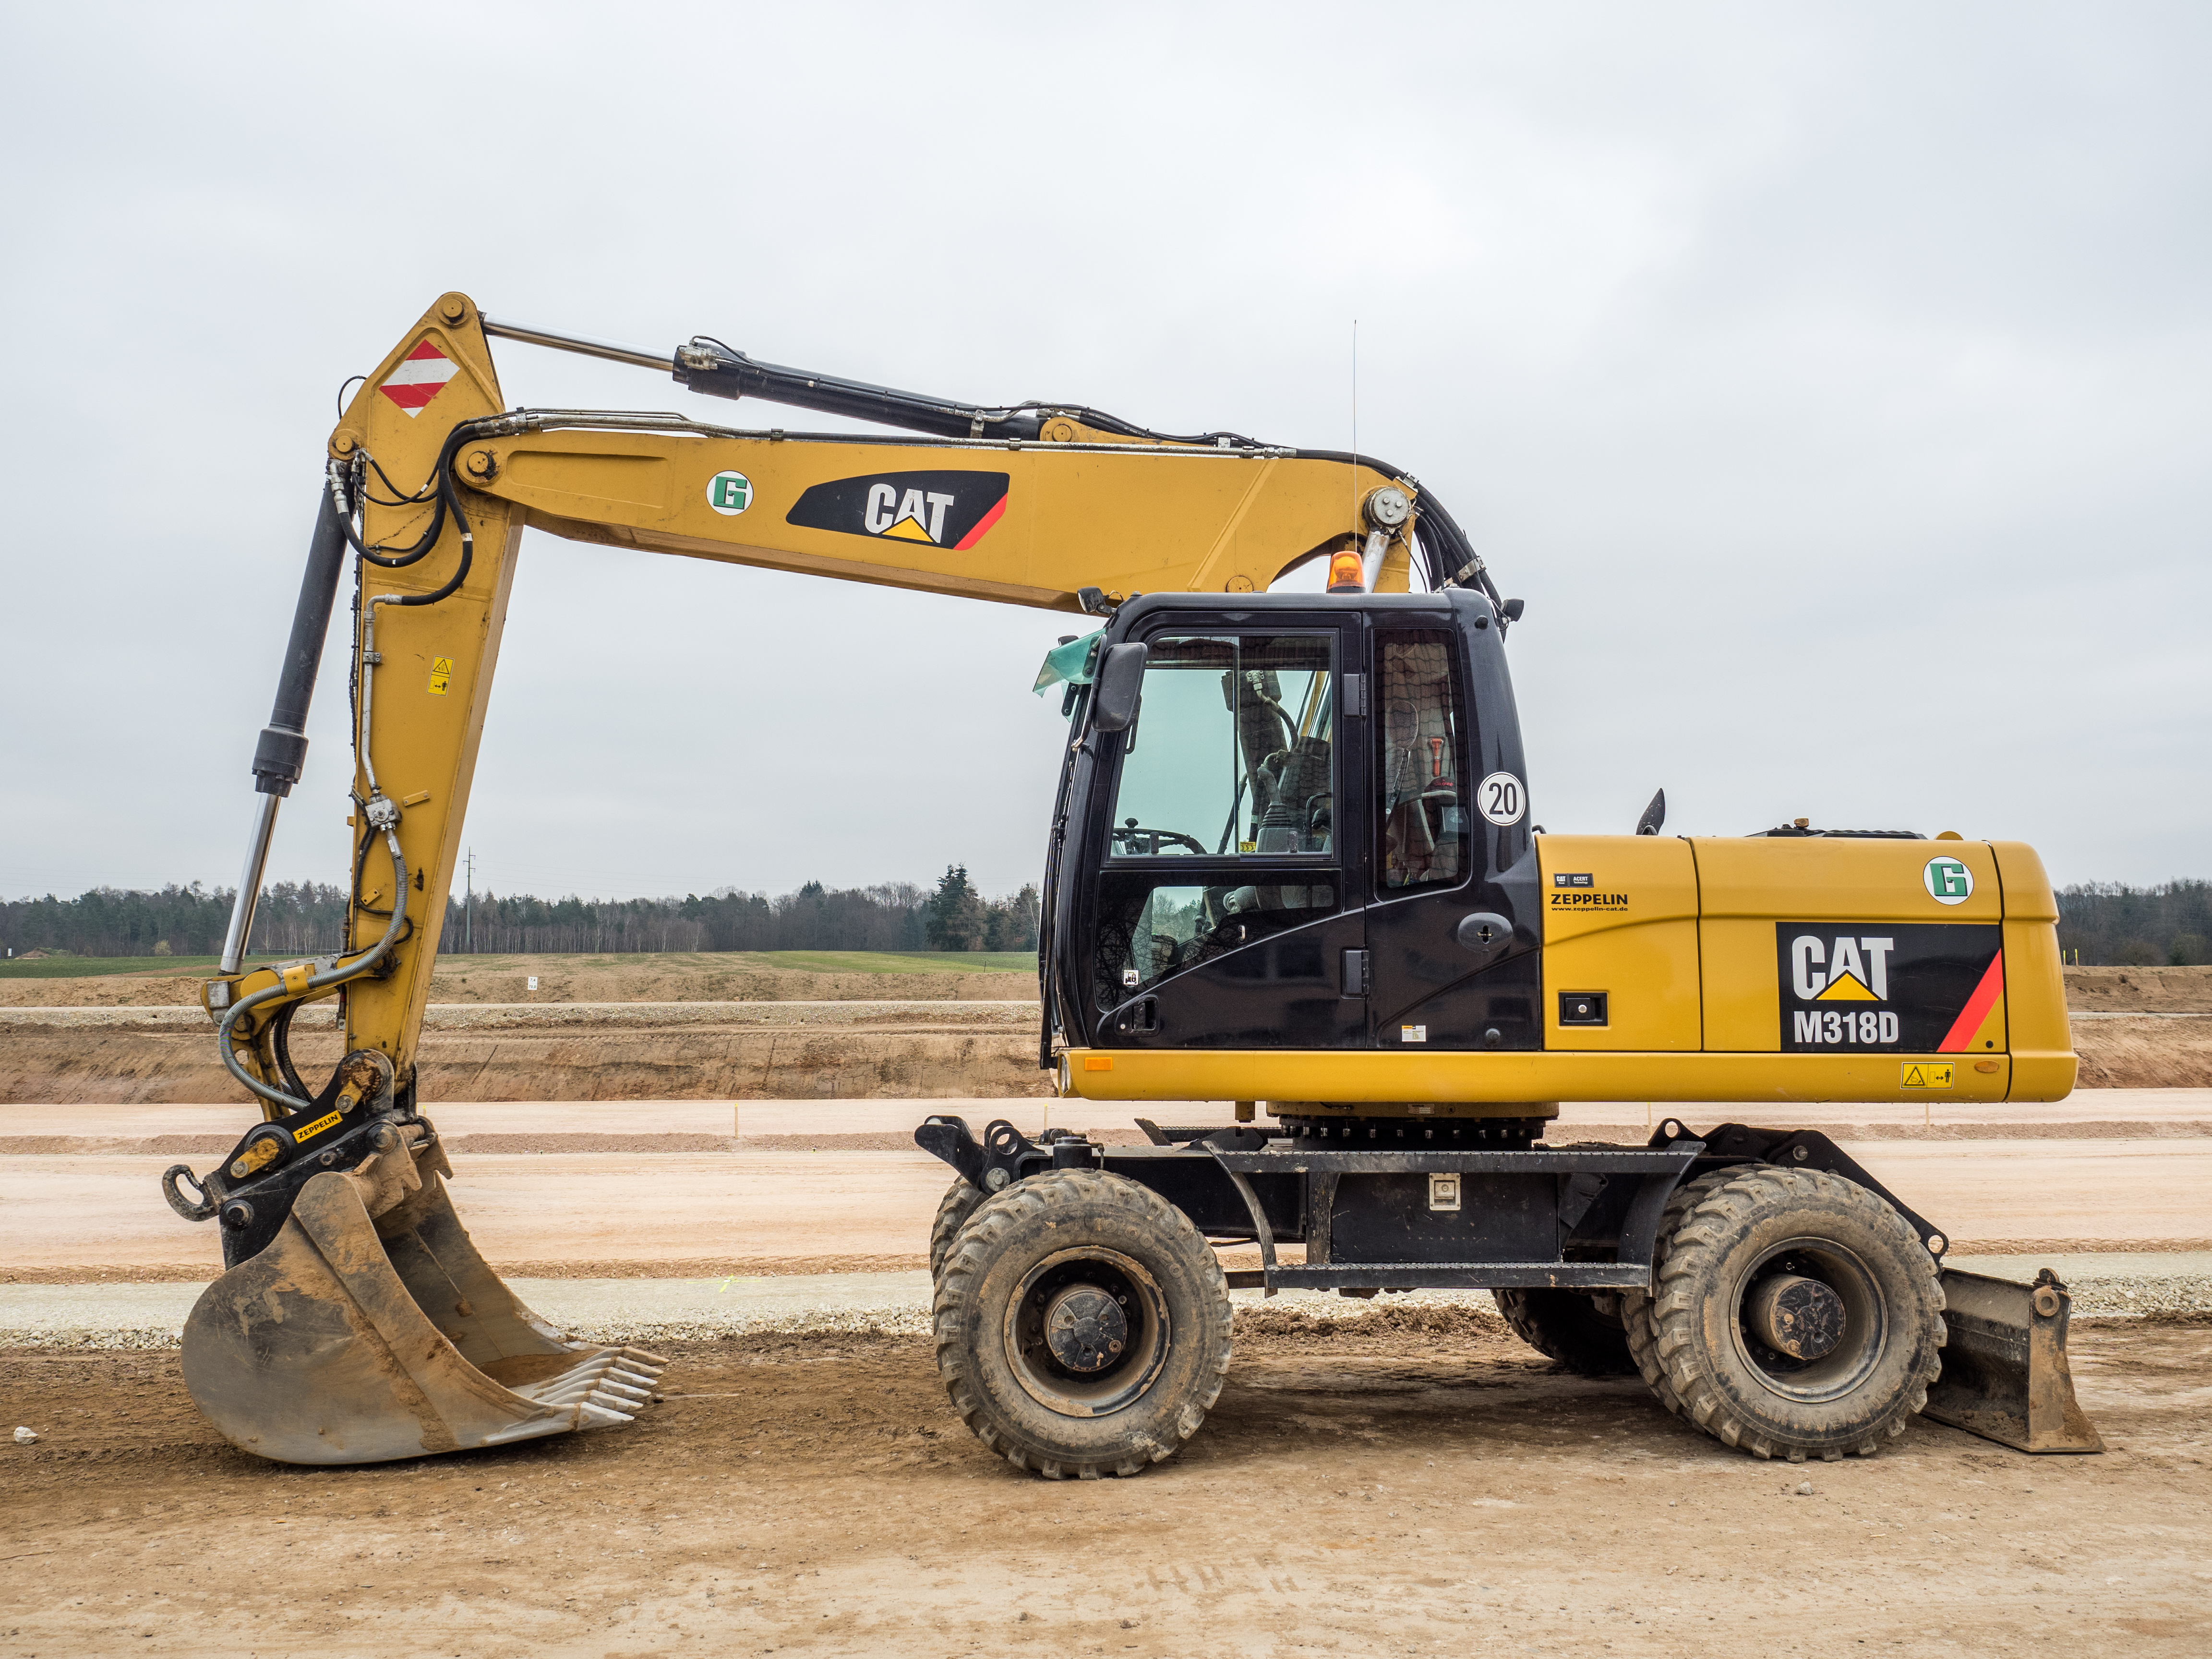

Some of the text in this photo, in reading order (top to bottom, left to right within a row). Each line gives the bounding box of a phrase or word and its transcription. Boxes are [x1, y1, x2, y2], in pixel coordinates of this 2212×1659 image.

[713, 476, 747, 510] G
[865, 483, 954, 543] CAT
[1489, 782, 1517, 816] 20
[1930, 863, 1968, 897] G
[1551, 894, 1628, 905] ZEPPELIN
[1791, 935, 1894, 1001] CAT
[1793, 1010, 1899, 1044] M318D
[297, 1114, 338, 1139] ZEPPELIN
